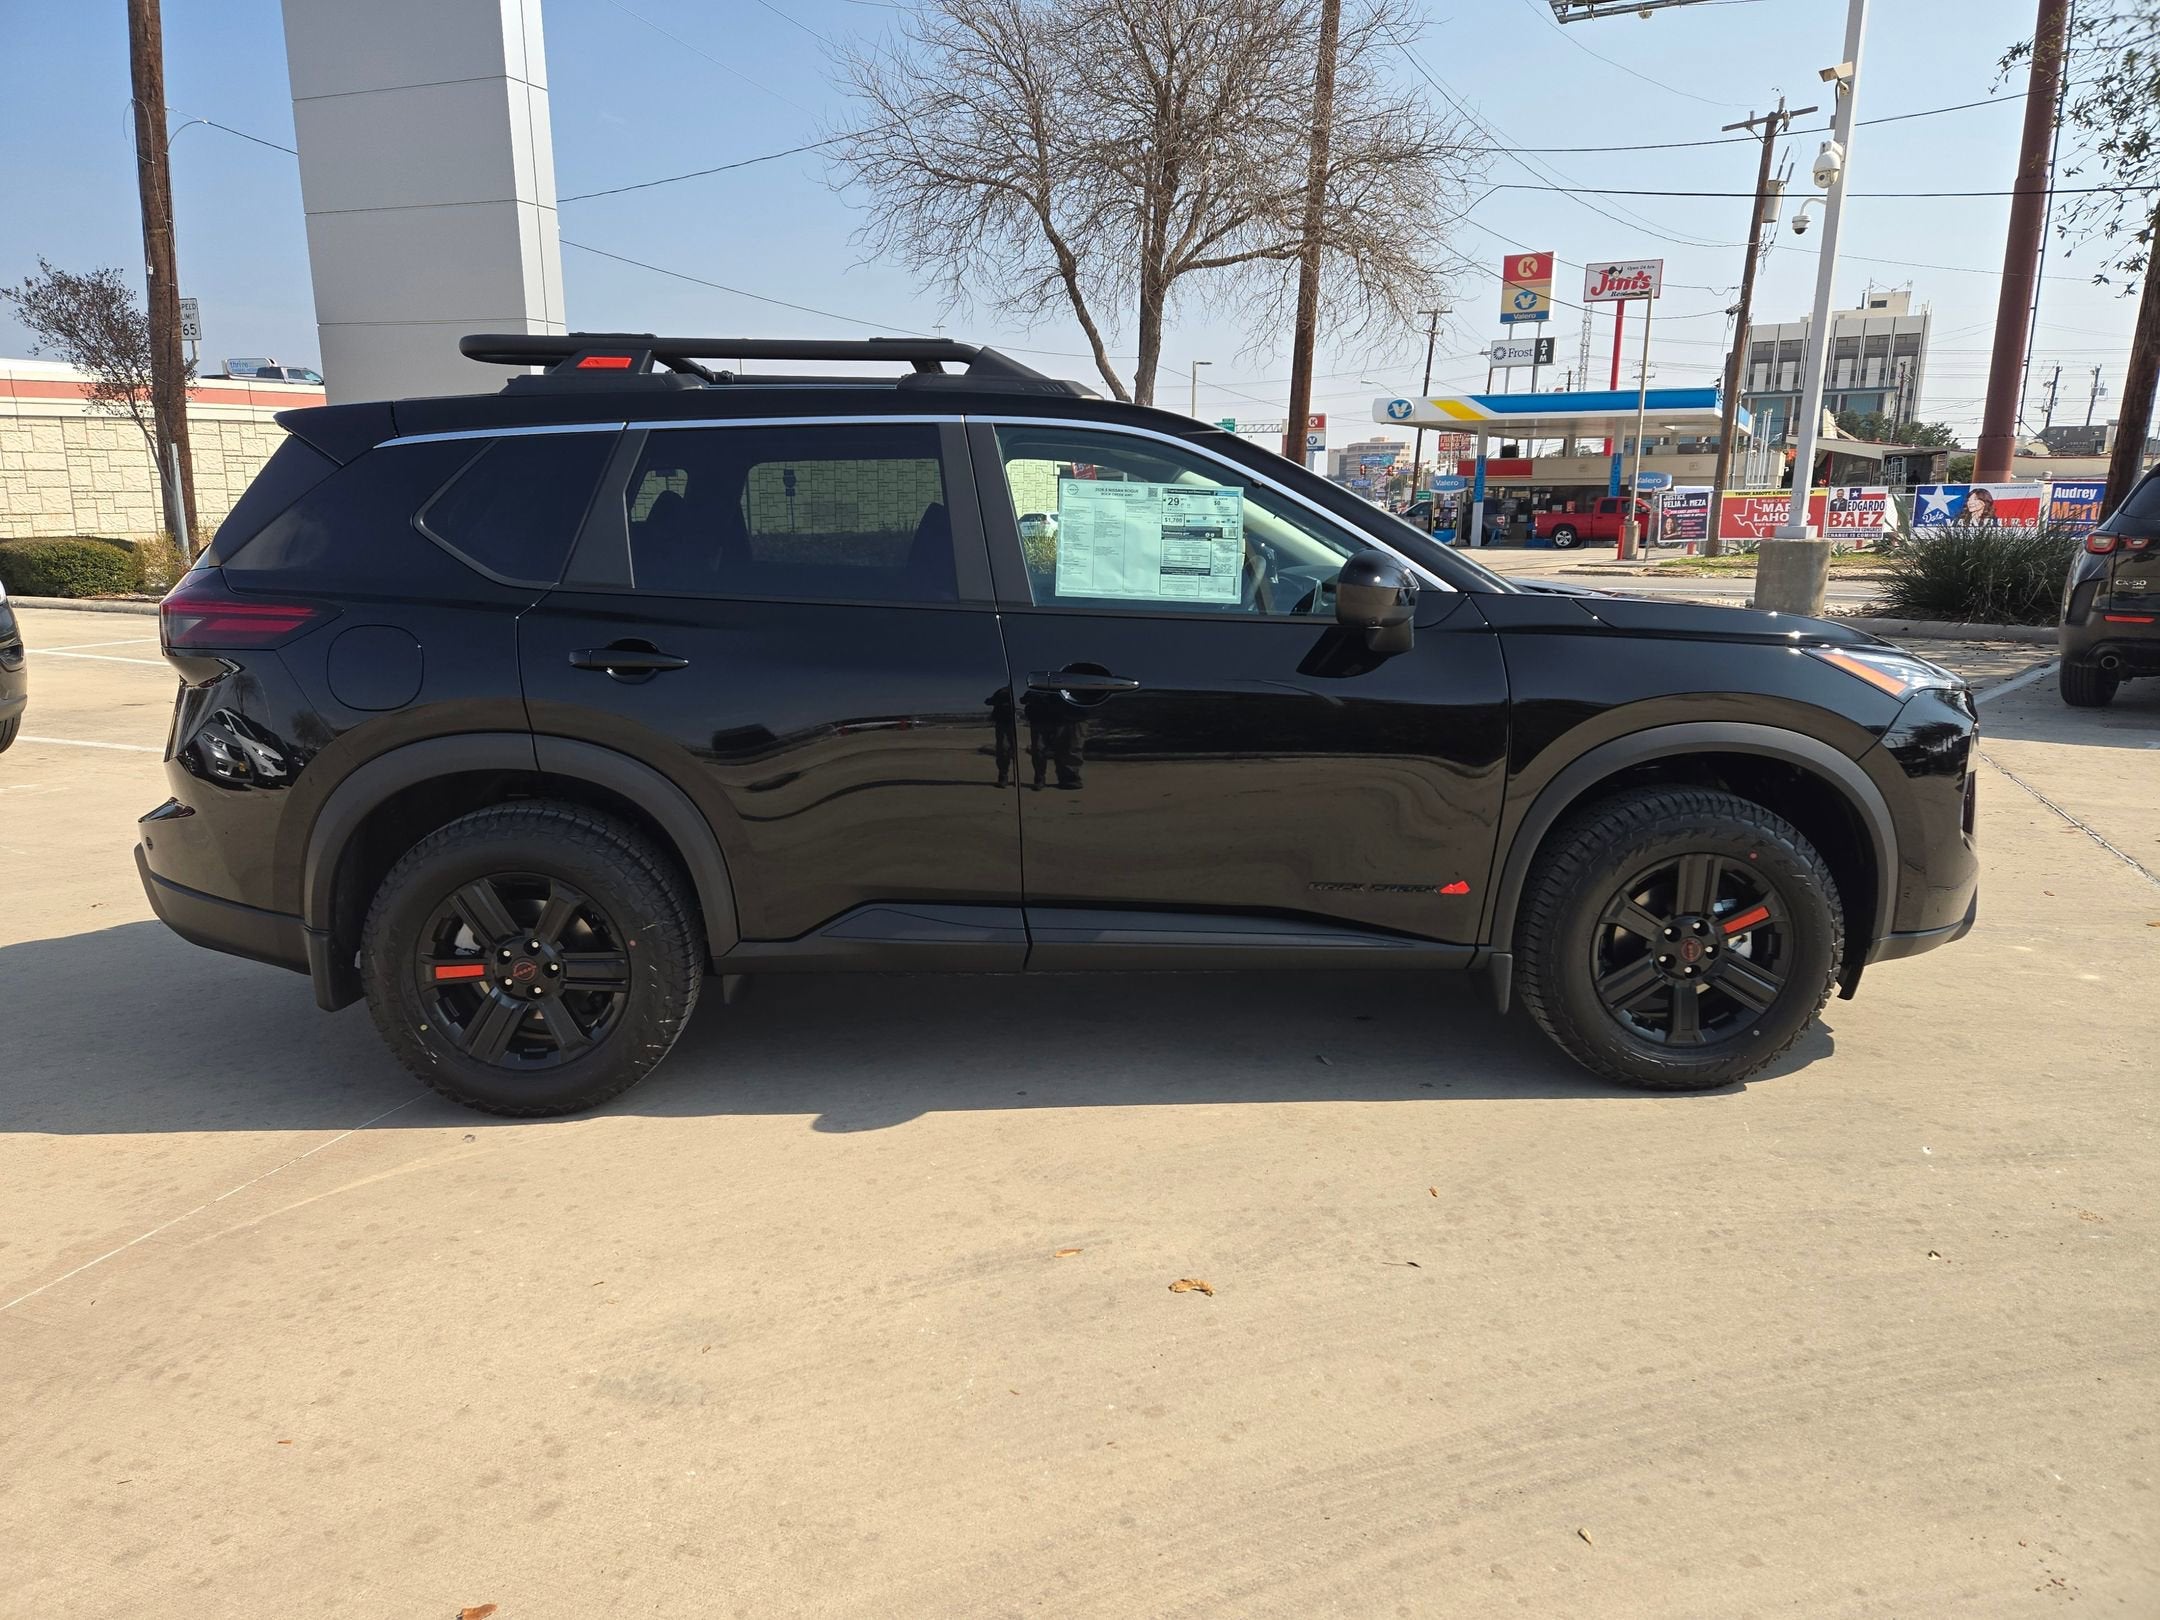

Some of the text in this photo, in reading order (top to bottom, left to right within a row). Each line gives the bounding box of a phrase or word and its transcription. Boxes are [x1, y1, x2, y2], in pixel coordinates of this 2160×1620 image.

[1590, 269, 1652, 296] Jim's
[182, 323, 197, 336] 65
[1508, 347, 1534, 358] Frost
[1539, 340, 1548, 362] ATM
[2053, 487, 2098, 500] Audrey
[1167, 497, 1180, 506] 29
[1847, 500, 1886, 511] EDGARDO
[1828, 511, 1884, 528] BAEZ
[1921, 512, 1944, 523] Vote
